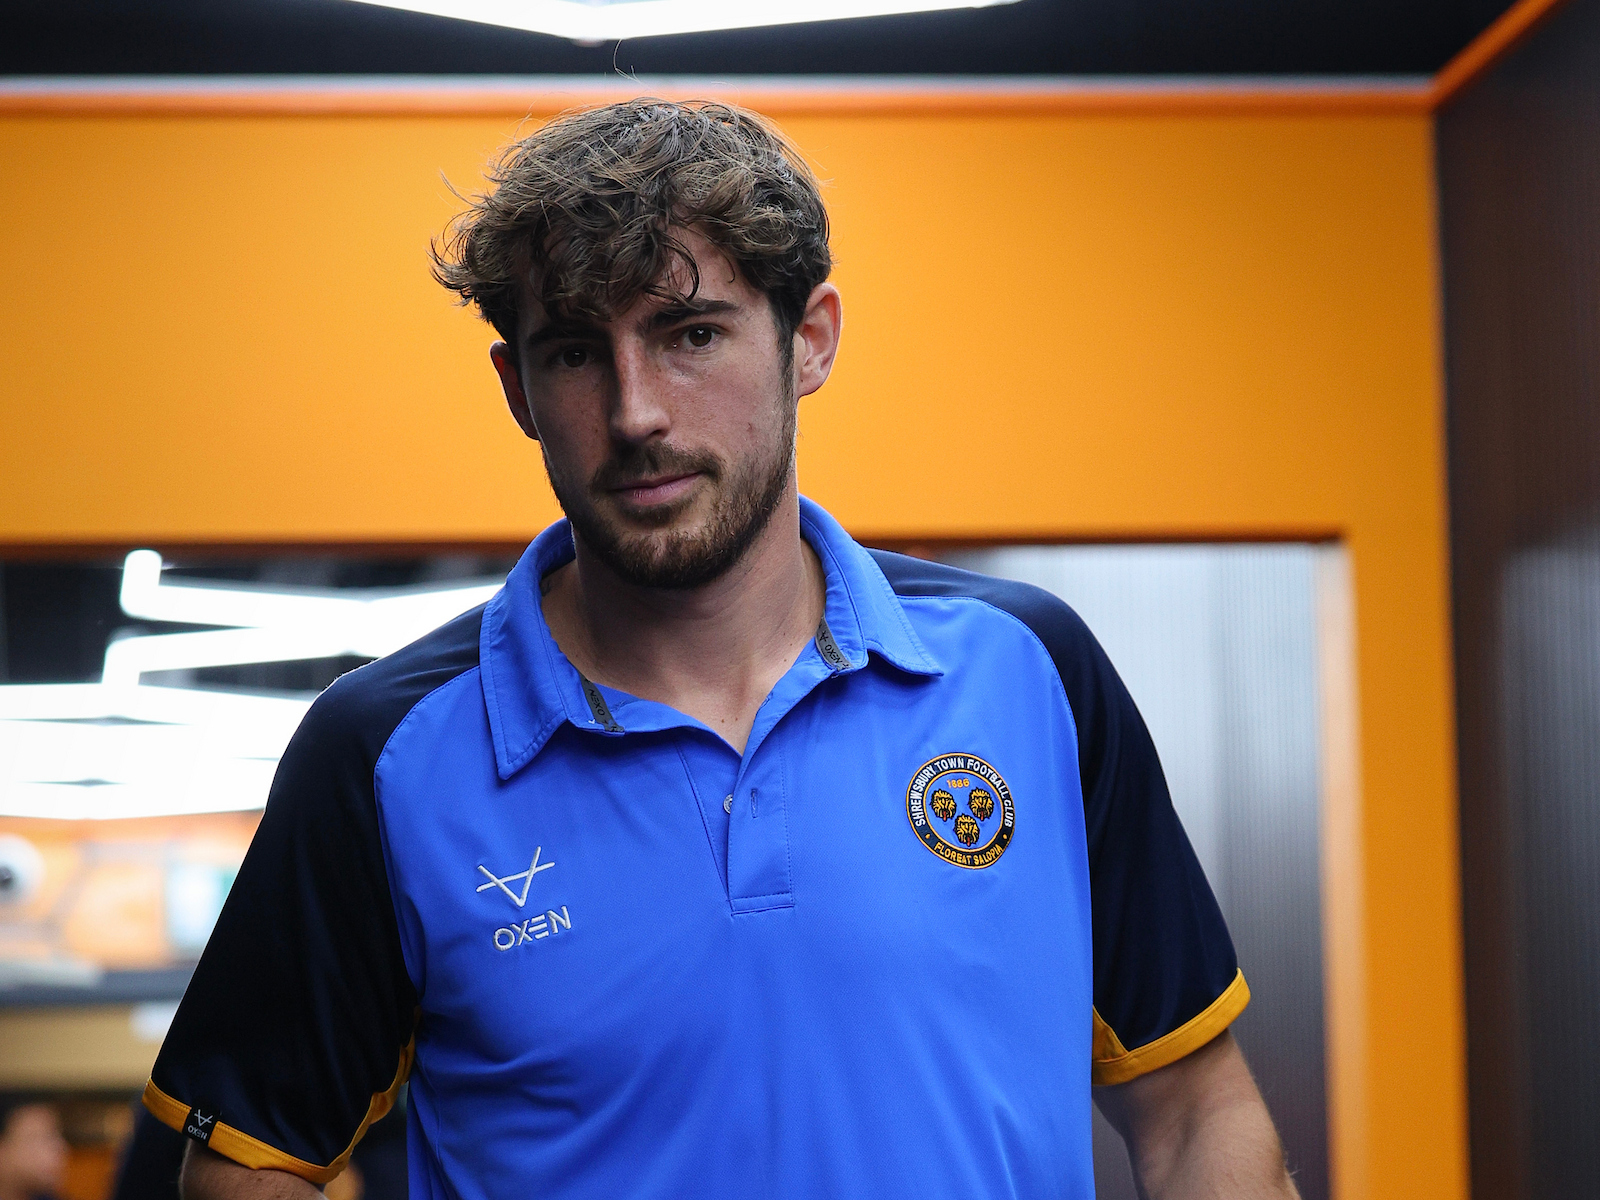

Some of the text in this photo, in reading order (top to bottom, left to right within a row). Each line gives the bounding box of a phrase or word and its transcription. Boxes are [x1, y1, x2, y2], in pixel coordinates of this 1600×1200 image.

[824, 644, 843, 663] OXEN
[589, 689, 605, 716] OXEN
[910, 757, 1014, 828] SHREWSBURY TOWN FOOTBALL CLUB
[946, 778, 970, 788] 1886
[934, 842, 1003, 865] FLOREAT SALOPIA
[493, 905, 571, 951] OXEN
[187, 1125, 208, 1140] OXEN
